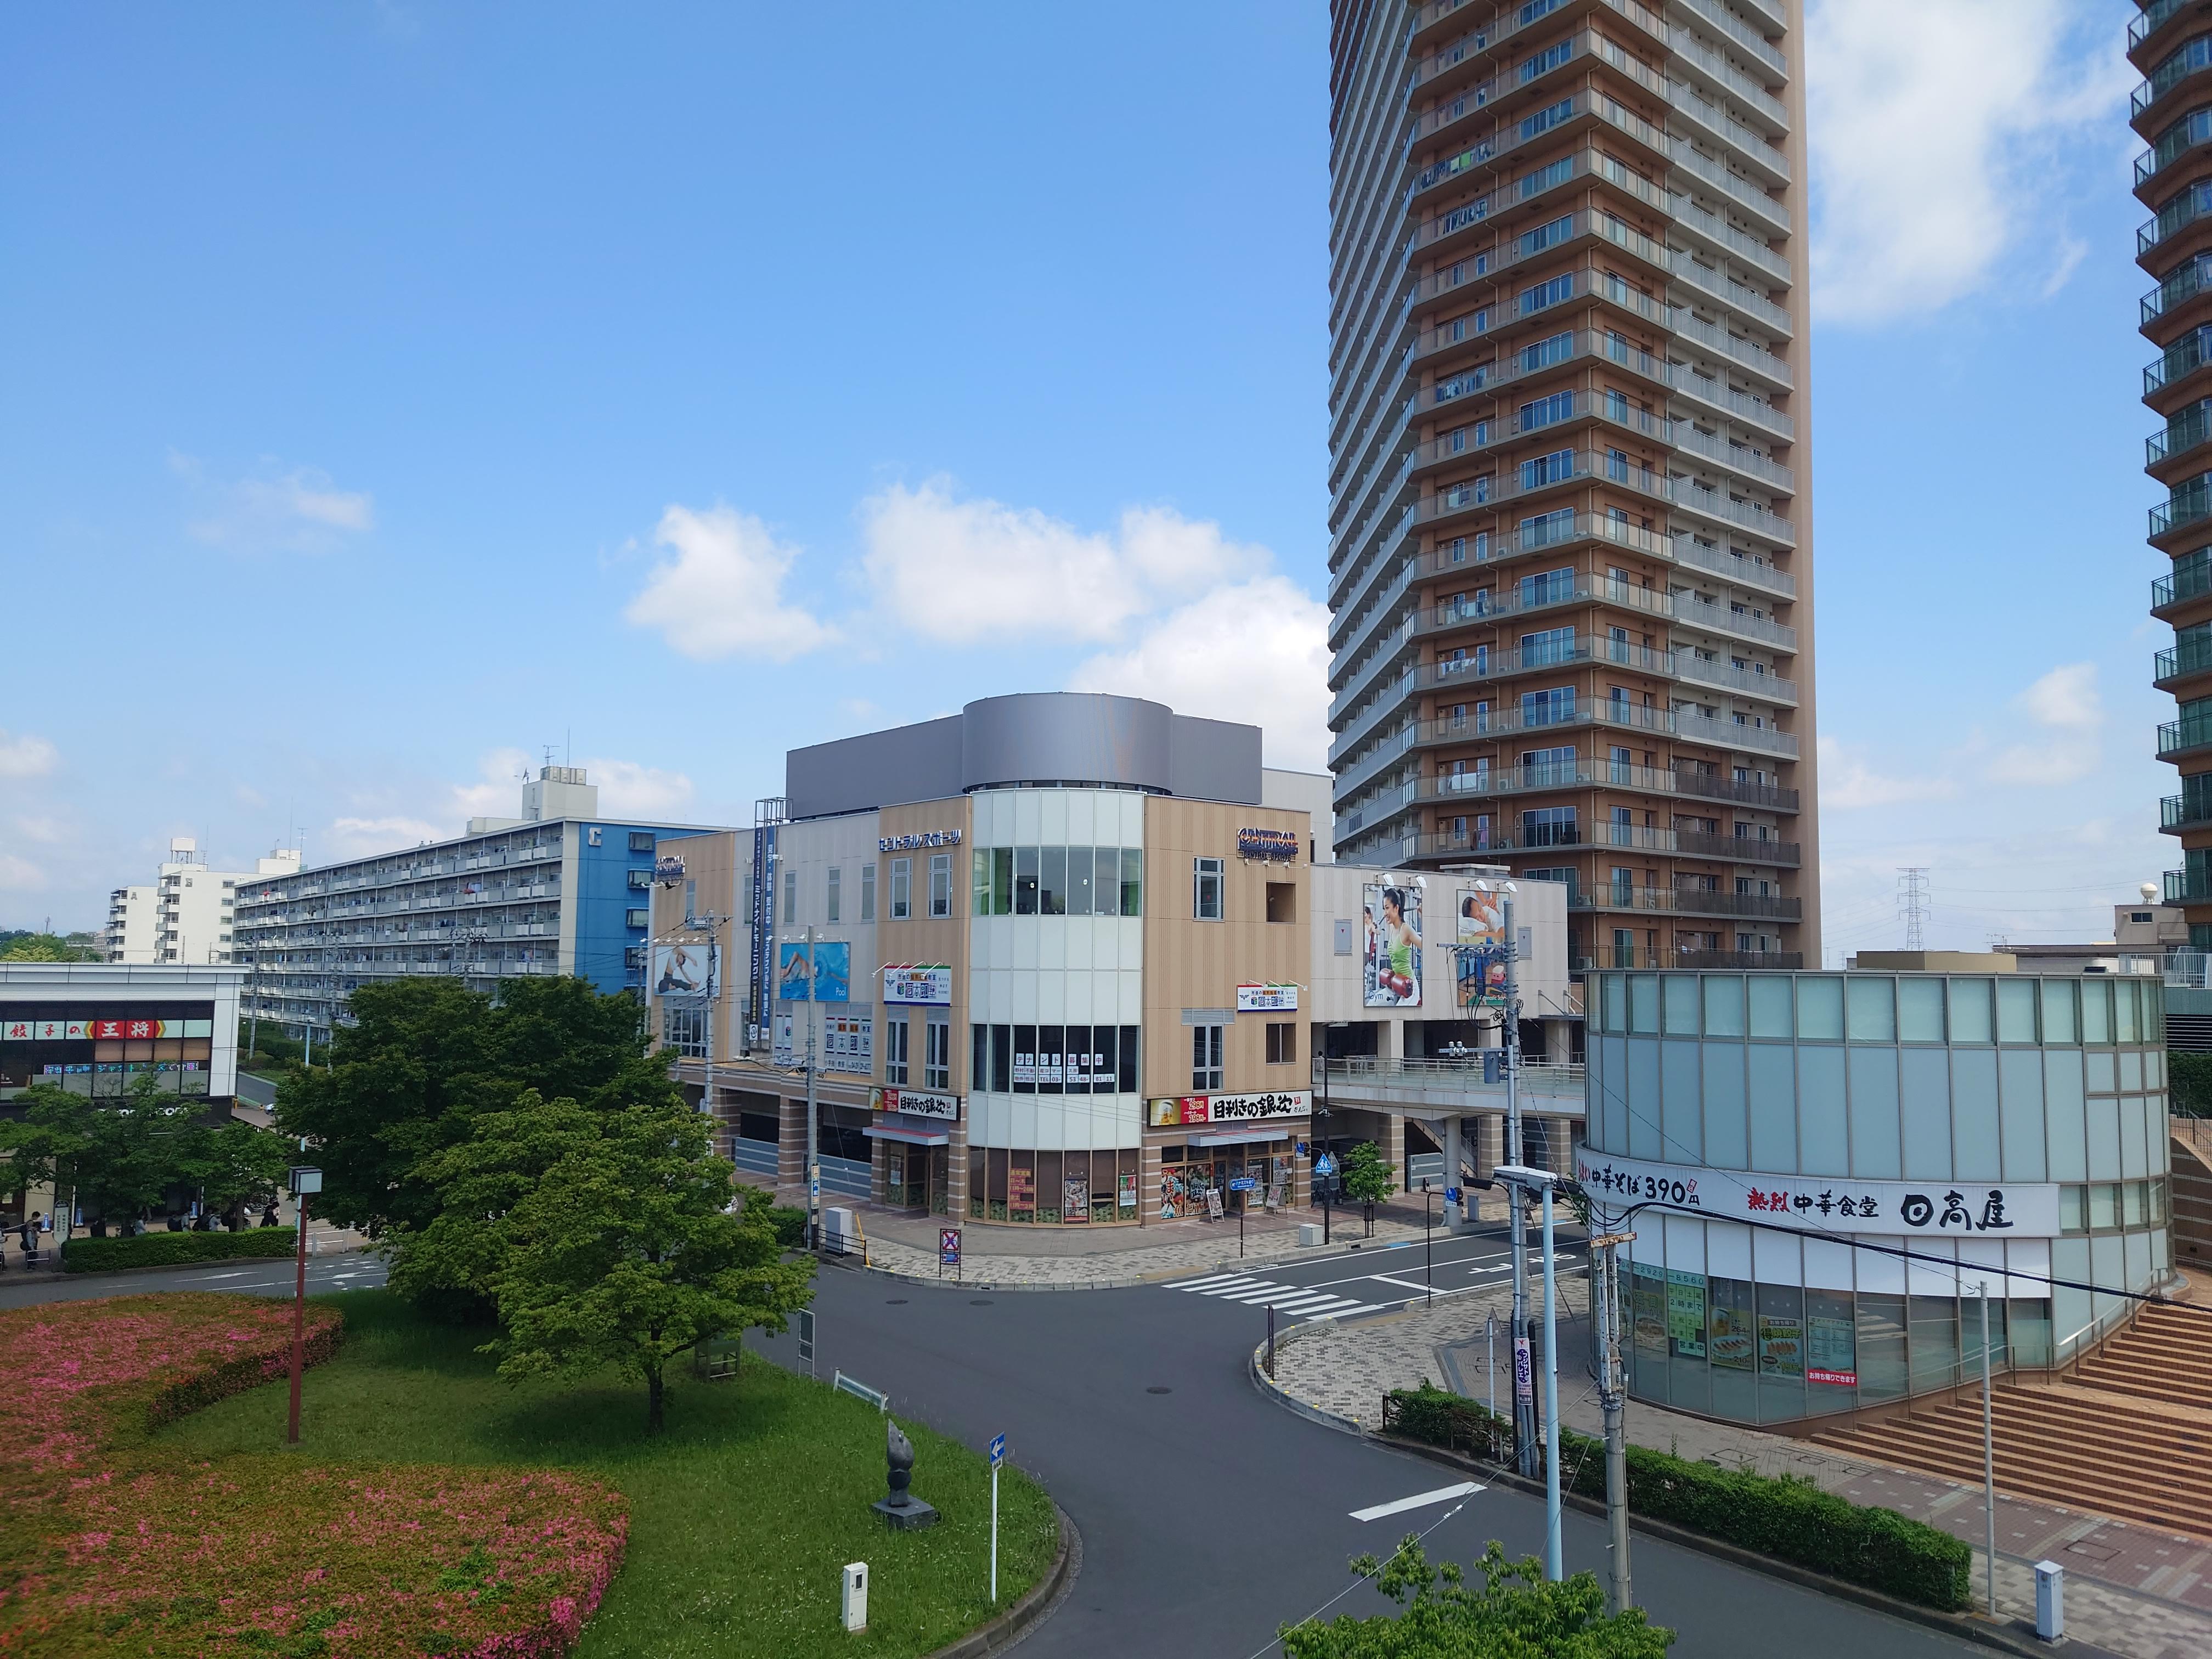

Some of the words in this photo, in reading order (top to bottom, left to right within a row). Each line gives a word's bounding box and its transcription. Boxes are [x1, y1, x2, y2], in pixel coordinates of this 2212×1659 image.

[589, 827, 601, 846] C
[879, 830, 962, 851] セントラルスポーツ
[836, 987, 847, 996] Pool
[1368, 990, 1383, 1002] Gym
[900, 1096, 946, 1114] 目利きの銀次
[1214, 1093, 1293, 1119] 目利きの銀次
[1900, 1189, 2013, 1231] 日高屋
[1679, 1341, 1704, 1351] 営業中
[1809, 1372, 1856, 1384] お持ち帰りできます
